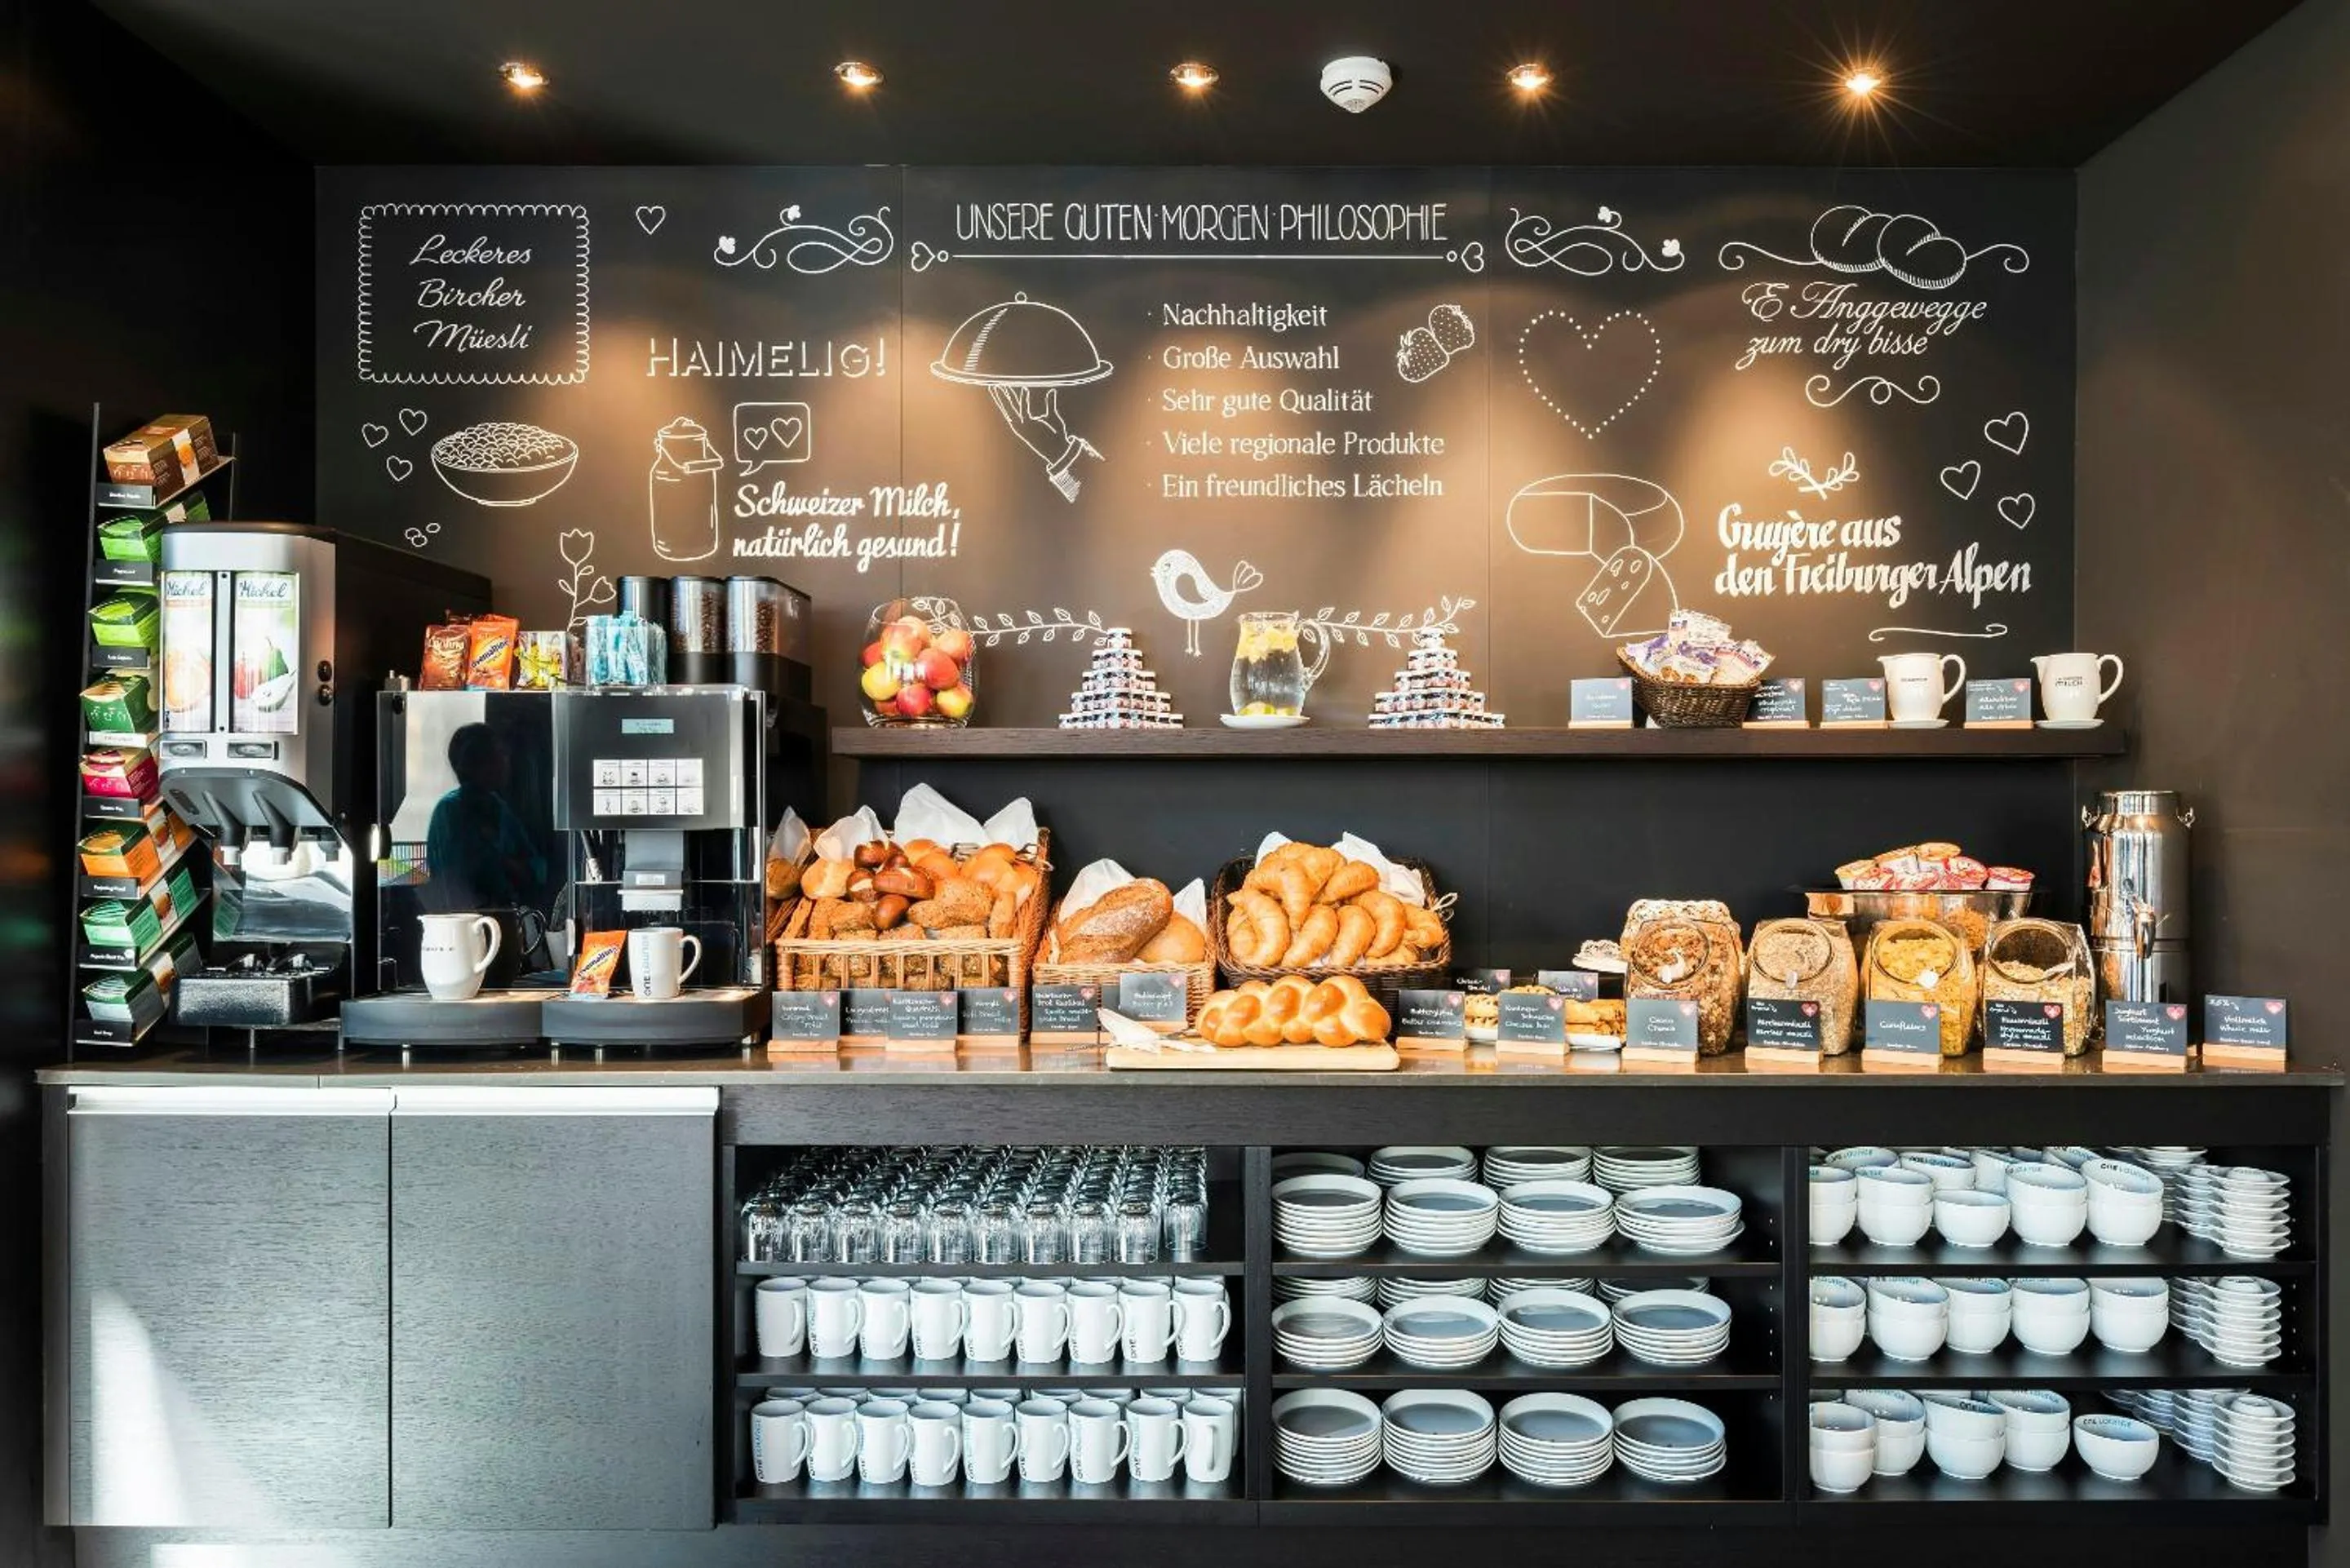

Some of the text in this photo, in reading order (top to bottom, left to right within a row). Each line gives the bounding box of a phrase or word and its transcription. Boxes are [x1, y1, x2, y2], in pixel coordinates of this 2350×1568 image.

[956, 202, 1055, 241] UNSERE
[408, 233, 533, 267] Leckeres
[416, 276, 527, 309] Bircher
[1741, 281, 1989, 336] E Anggewegge
[1162, 300, 1329, 333] Nachhaltigkeit
[411, 318, 532, 352] Müesli
[1735, 322, 1929, 371] zum dry bisse
[646, 336, 886, 379] HAIMELIG!
[1162, 344, 1341, 370] Große Auswahl
[1161, 387, 1375, 419] Sehr gute Qualität
[1162, 429, 1446, 462] Viele regionale Produkte
[733, 479, 961, 520] Schweizer Milch,
[1162, 472, 1443, 498] Ein freundliches Lächeln
[731, 521, 962, 574] natürlich gesund!
[1718, 502, 1903, 567] Gruyère aus
[1714, 540, 2032, 611] den Freiburger Alpen
